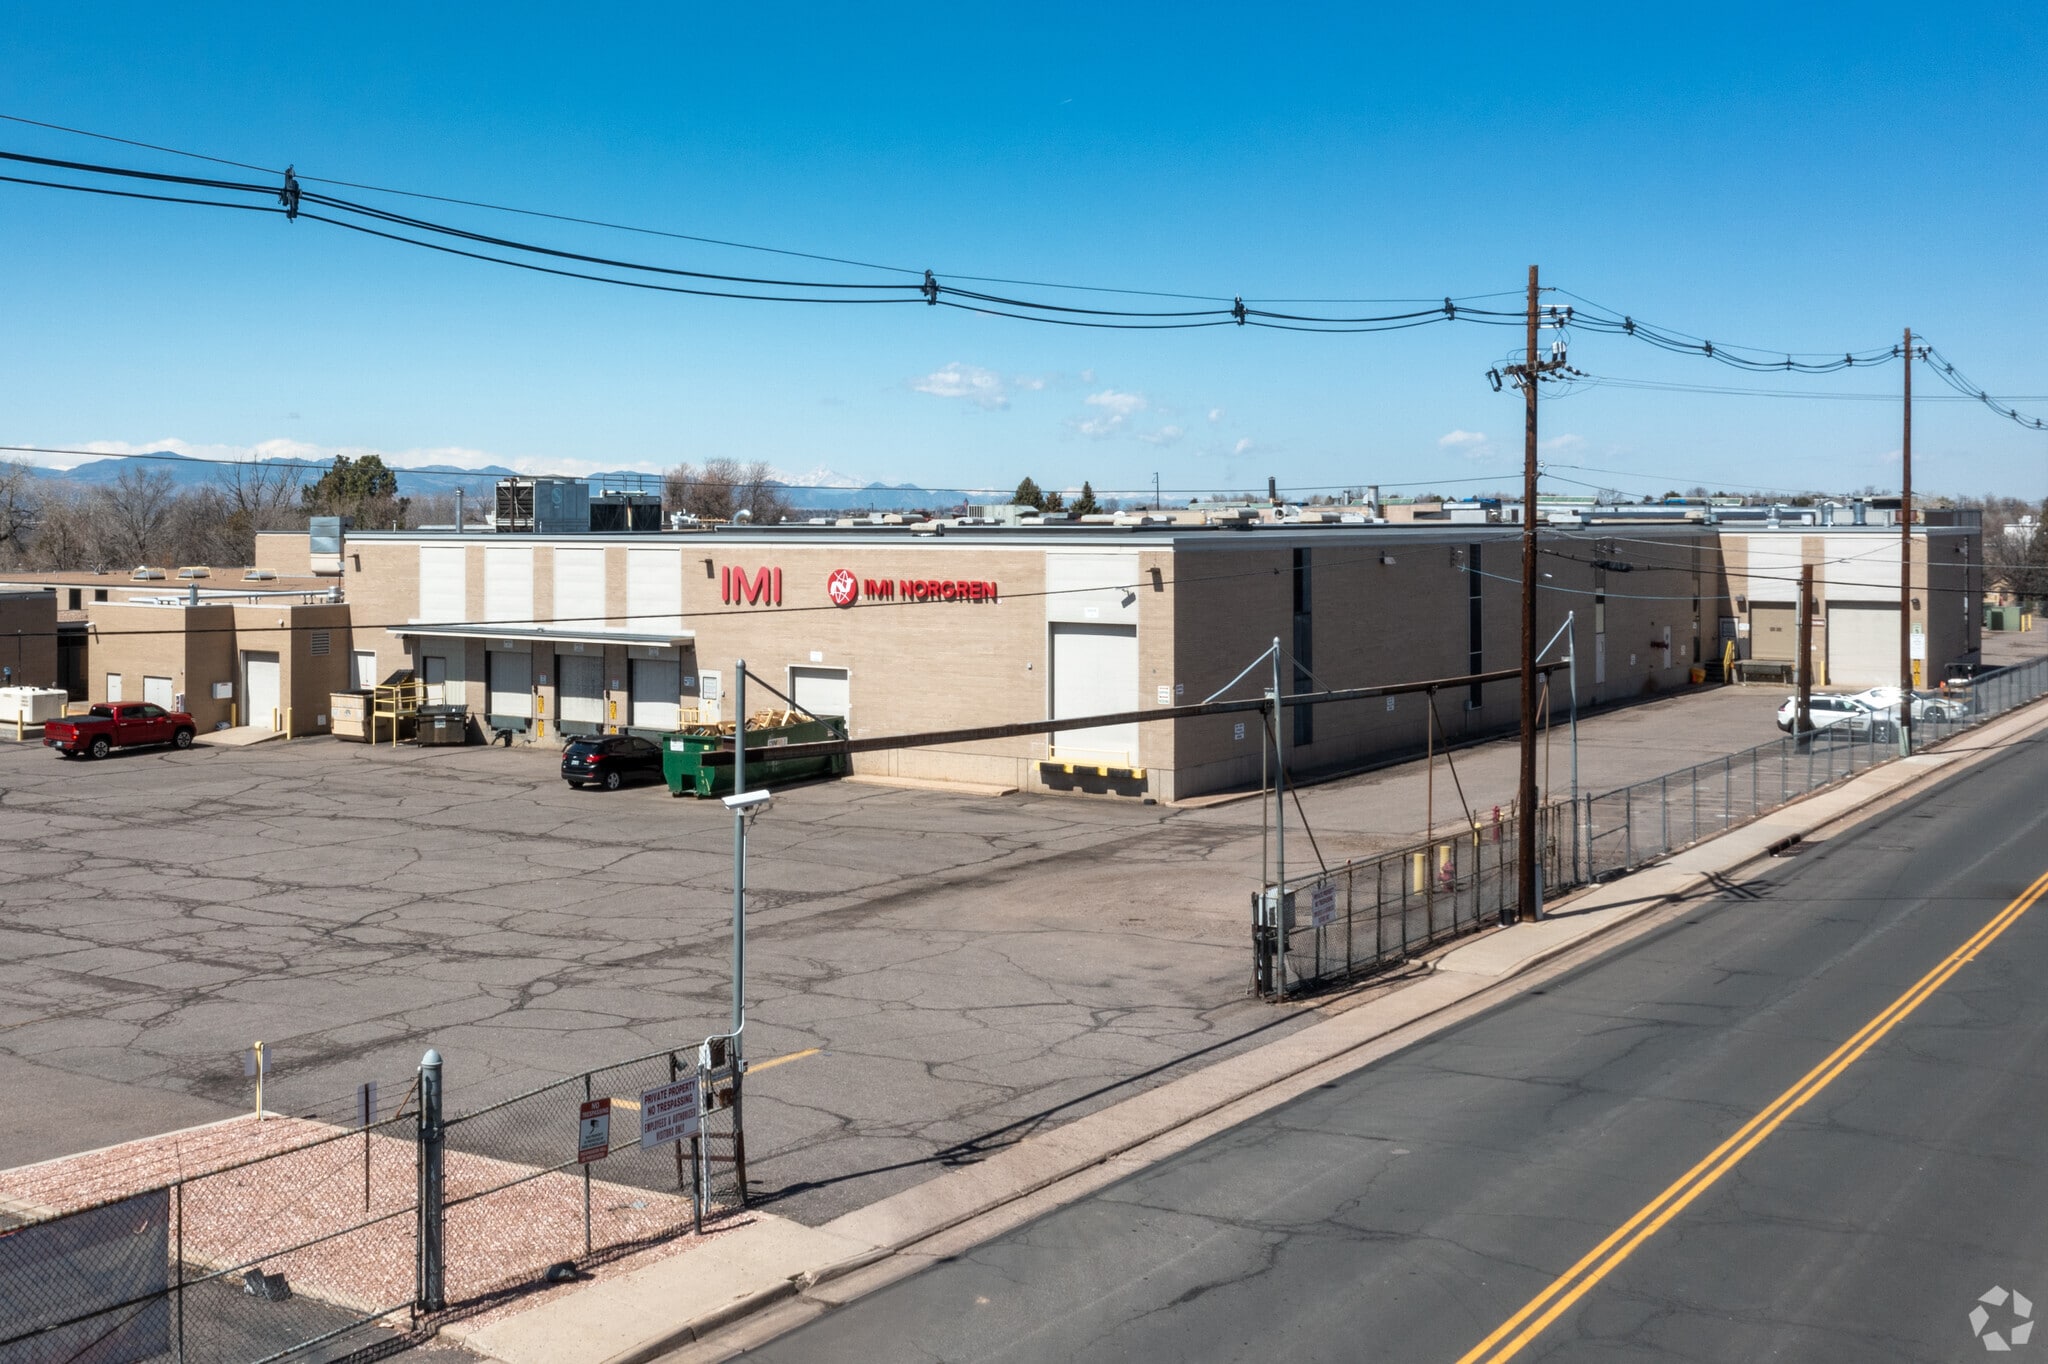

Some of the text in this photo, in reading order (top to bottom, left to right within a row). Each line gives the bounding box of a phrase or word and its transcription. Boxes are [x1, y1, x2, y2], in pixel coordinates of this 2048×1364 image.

[721, 565, 781, 605] IMI
[863, 578, 996, 600] IMI NORGREN
[644, 1081, 696, 1105] PRIVATE PROPERTY
[647, 1093, 694, 1117] NO TRESPASSING
[591, 1101, 600, 1110] NO
